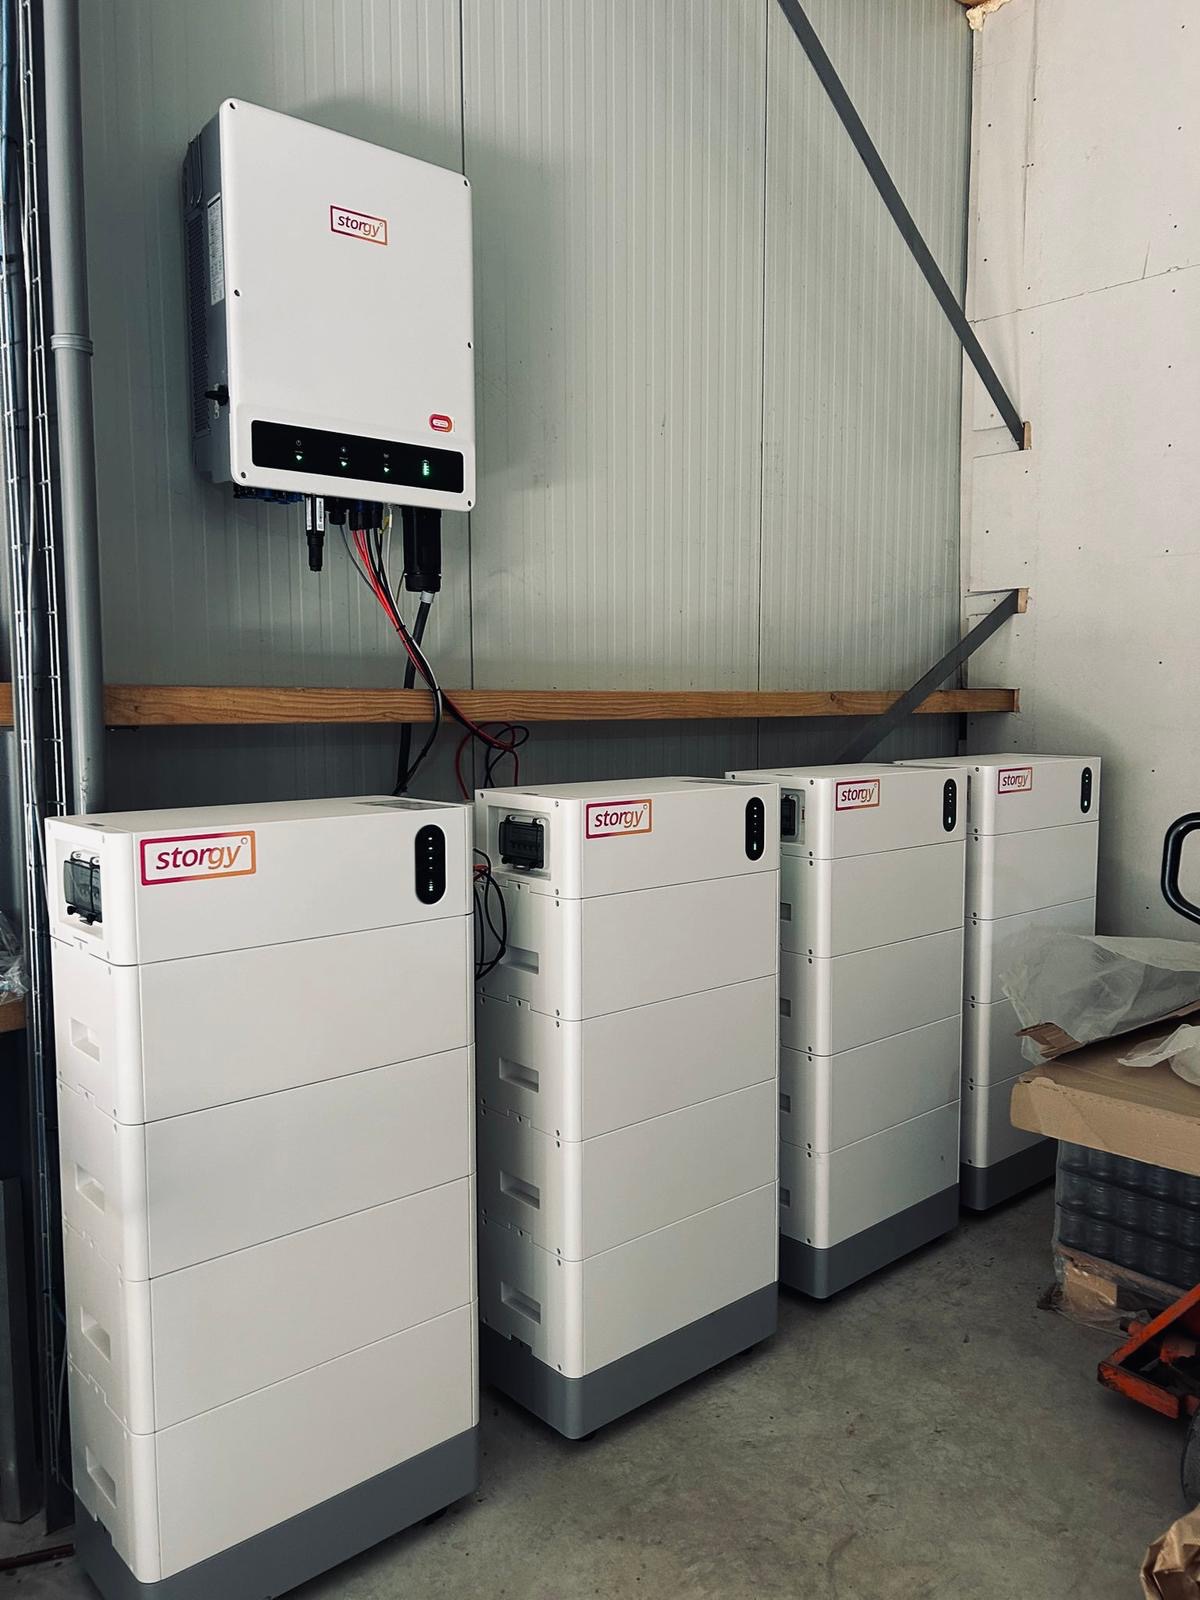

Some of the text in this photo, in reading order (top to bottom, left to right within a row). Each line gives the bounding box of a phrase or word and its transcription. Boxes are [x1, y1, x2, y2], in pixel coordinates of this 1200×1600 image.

[338, 215, 380, 237] storgy
[841, 787, 874, 803] storgy
[594, 809, 644, 829] storgy
[156, 844, 242, 870] storgy
